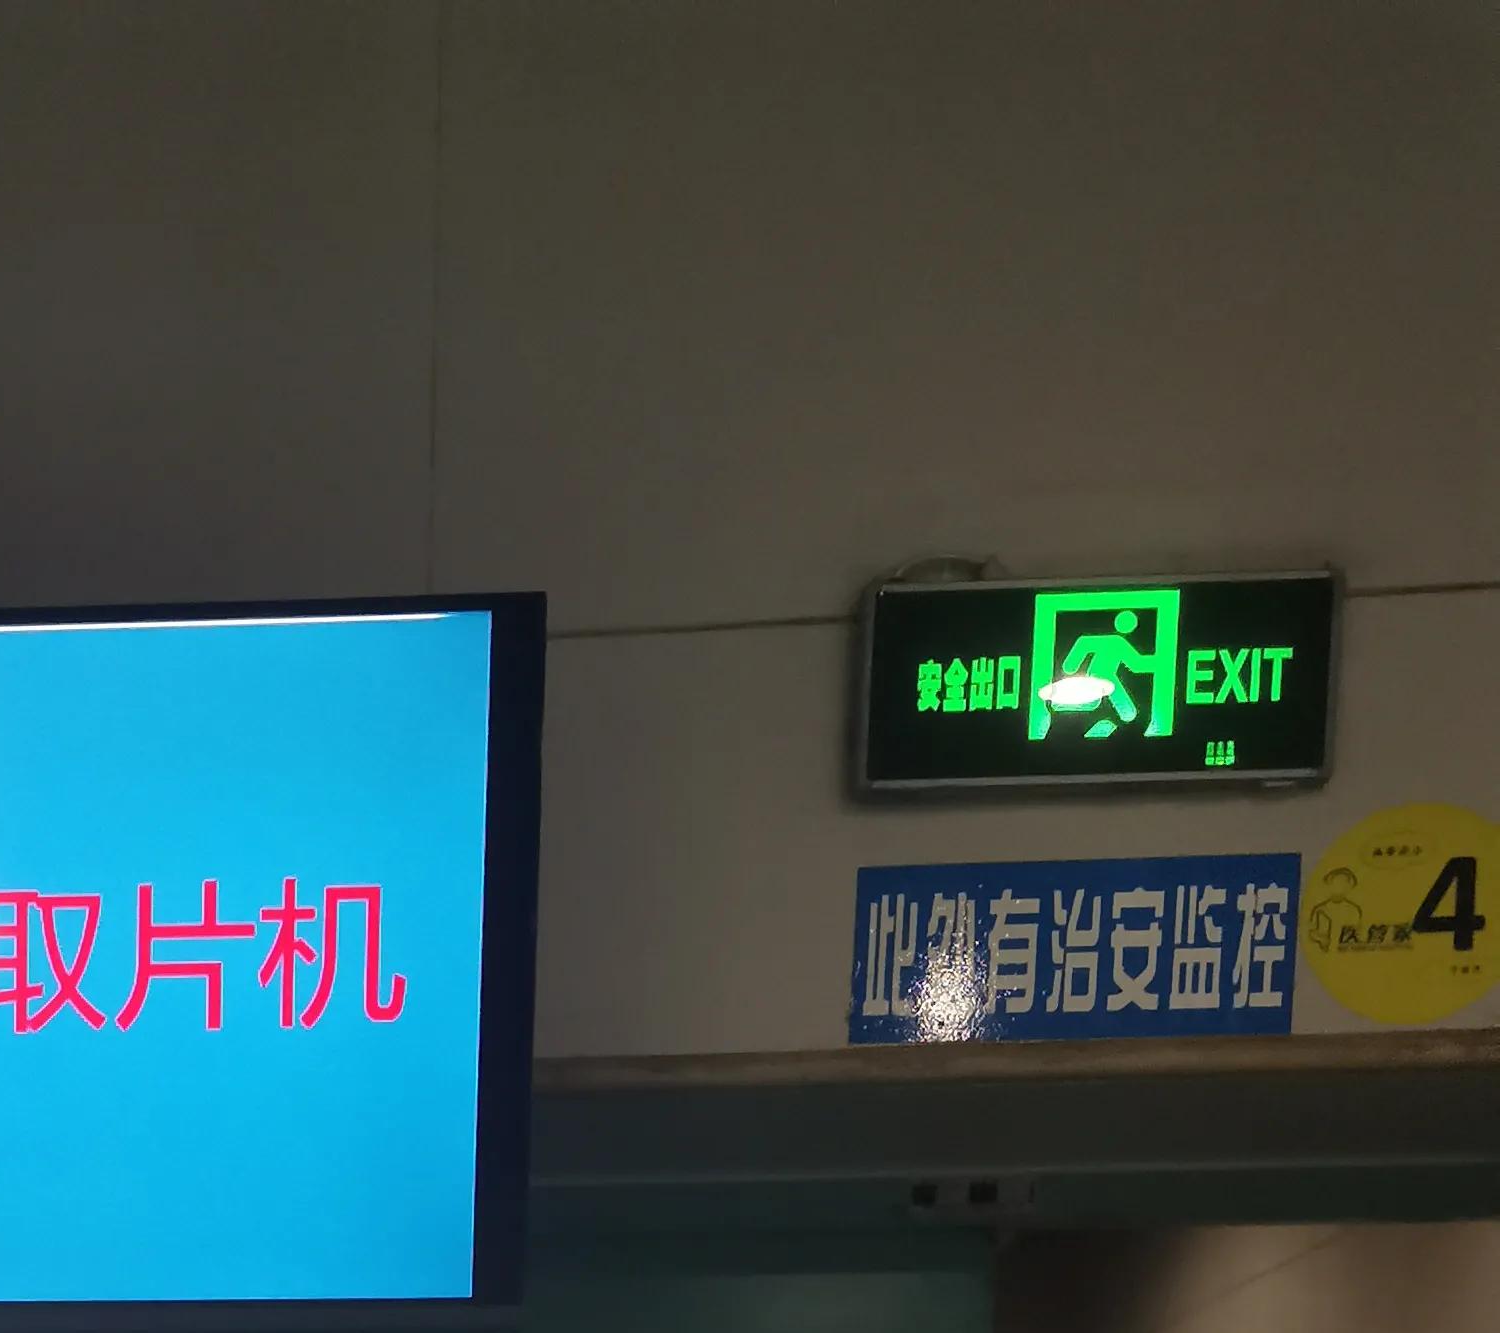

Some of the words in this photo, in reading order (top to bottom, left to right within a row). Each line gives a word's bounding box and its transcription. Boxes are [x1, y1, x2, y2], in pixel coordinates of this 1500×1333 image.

[916, 655, 1021, 713] 安全出口
[1186, 647, 1294, 704] EXIT
[1414, 856, 1486, 951] 4
